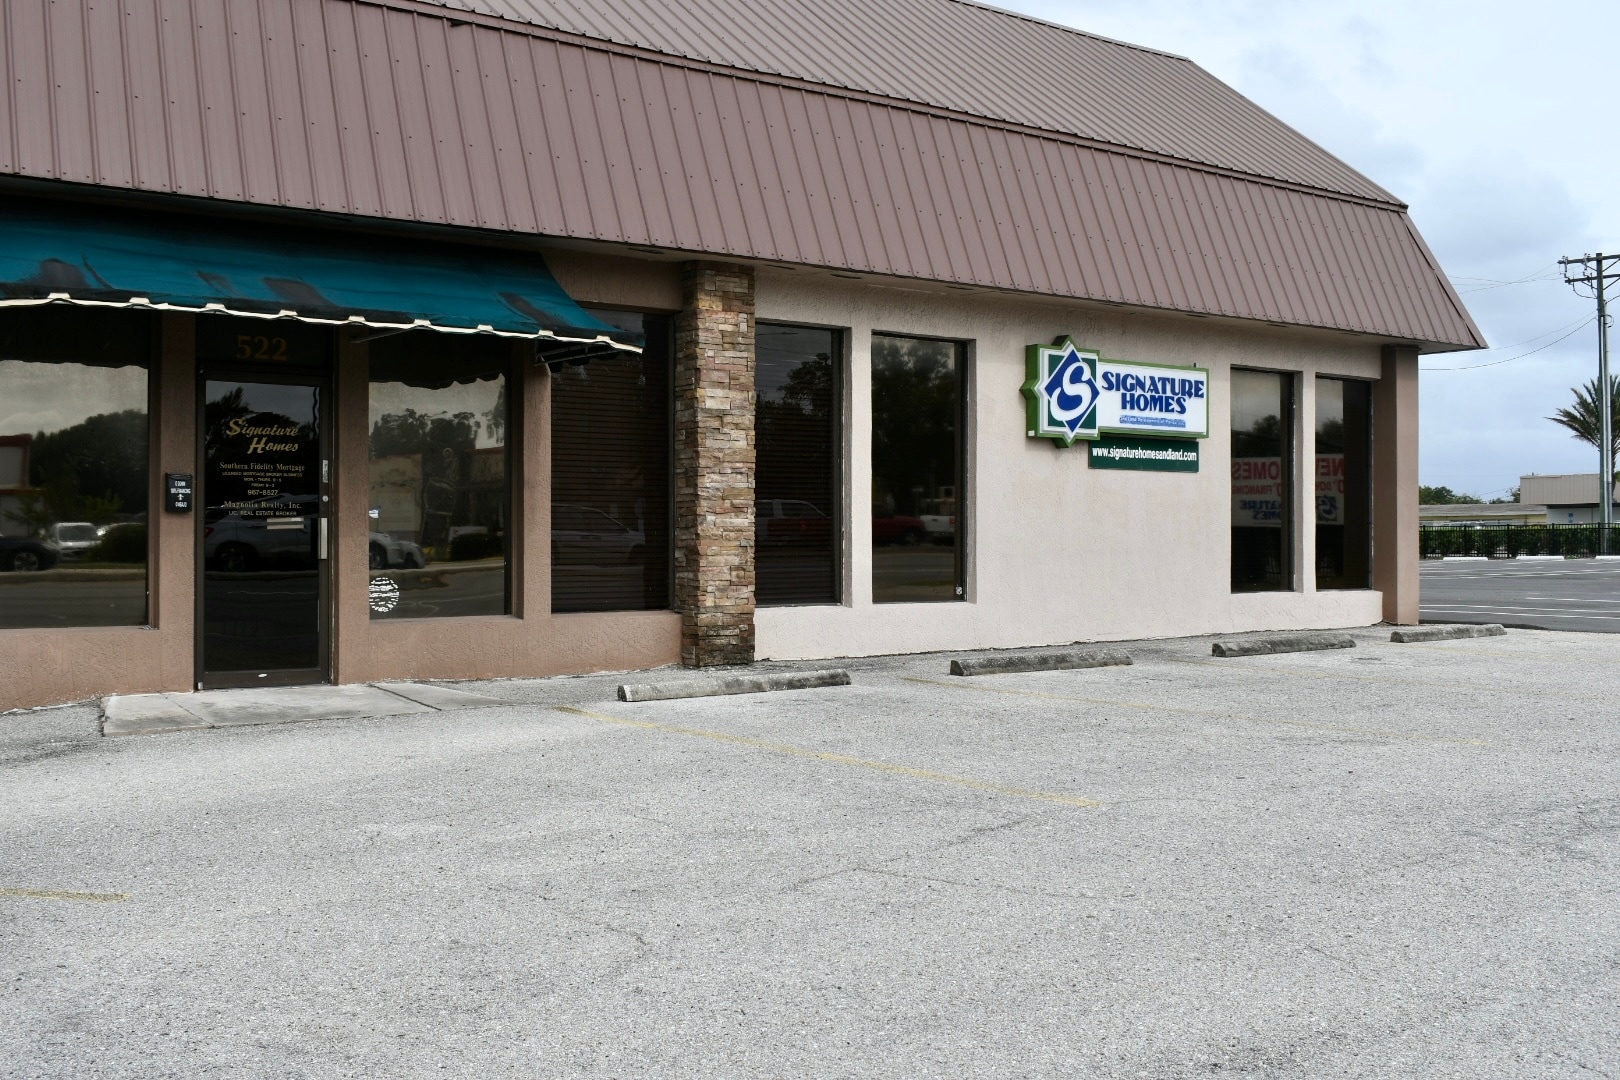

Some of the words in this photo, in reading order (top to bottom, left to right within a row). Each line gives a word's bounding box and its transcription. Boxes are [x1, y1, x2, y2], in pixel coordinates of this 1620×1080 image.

[236, 335, 288, 361] 522
[1102, 371, 1205, 398] SIGNATURE
[1121, 392, 1187, 415] HOMES
[226, 418, 299, 438] Signature
[246, 437, 299, 455] Homes
[1092, 445, 1197, 461] www.signaturehomesandland.com
[220, 462, 248, 470] Southern
[250, 462, 274, 471] Fidelity
[276, 463, 305, 472] Mortgage
[224, 500, 258, 510] Magnolia
[261, 501, 287, 510] Realty,
[289, 501, 303, 509] Inc.
